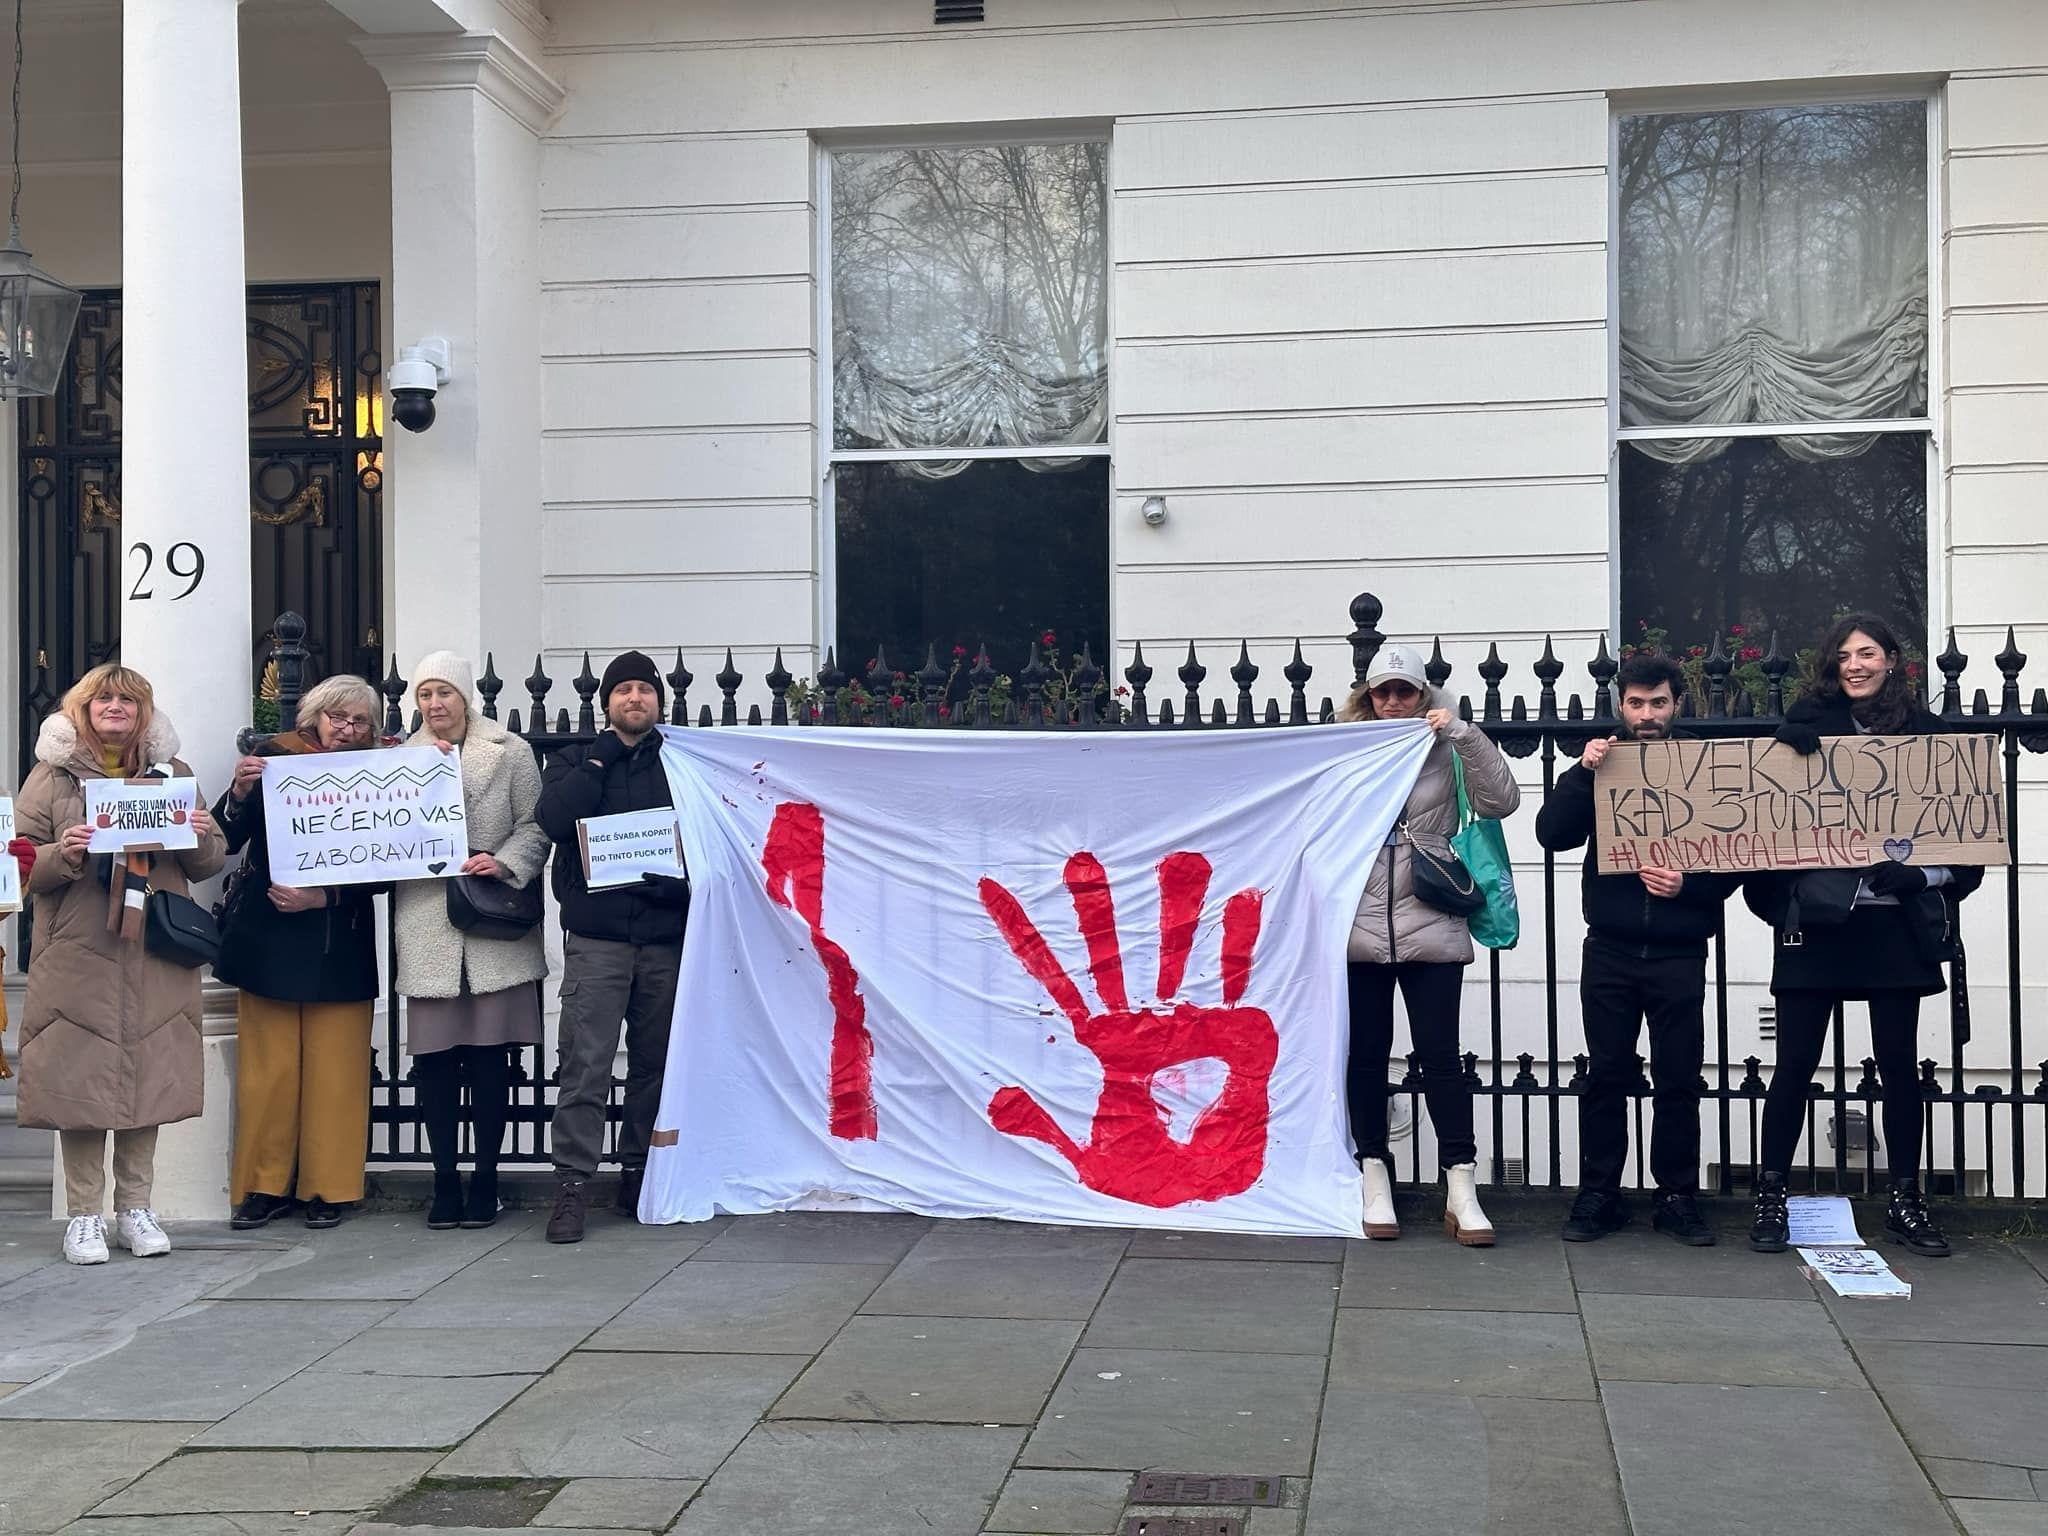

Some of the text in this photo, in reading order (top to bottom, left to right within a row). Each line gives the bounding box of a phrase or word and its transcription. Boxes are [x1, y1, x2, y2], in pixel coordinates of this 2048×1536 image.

[129, 542, 205, 601] 29
[1640, 740, 1787, 794] UVEK
[117, 799, 167, 812] RUKE SU VAM
[118, 810, 168, 830] KRVAVE!
[292, 804, 464, 834] NEĆEMO VAS
[1609, 788, 1694, 838] KAD
[1701, 787, 1900, 834] STUDENTI
[591, 847, 674, 863] RIO TINTO FUCK OFF
[1608, 826, 1871, 870] #LONDONCALLING
